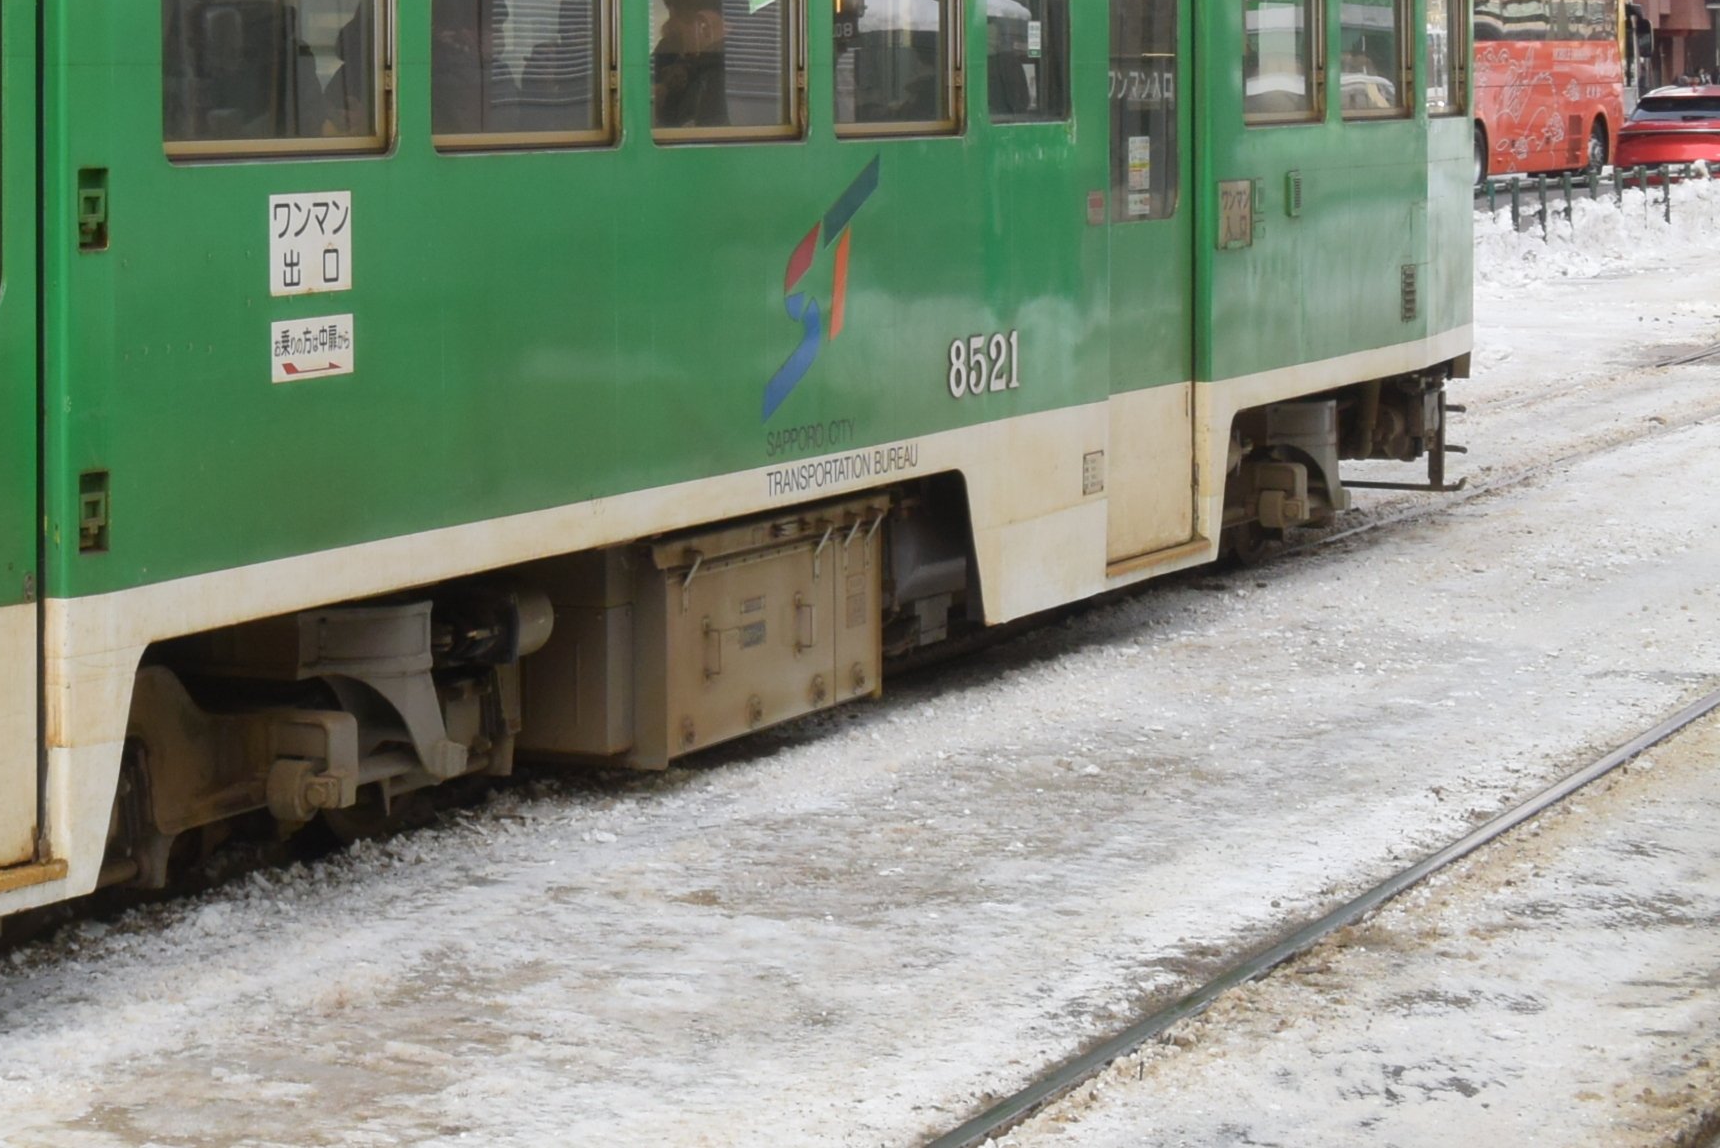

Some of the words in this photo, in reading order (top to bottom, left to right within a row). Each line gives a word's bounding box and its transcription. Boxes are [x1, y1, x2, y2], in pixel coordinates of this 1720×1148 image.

[273, 200, 349, 239] ワンマン
[283, 248, 340, 288] 出口
[274, 324, 351, 358] お乗りの方は中扉から
[947, 329, 1022, 400] 8521
[766, 423, 826, 458] SAPPORO
[828, 417, 857, 446] CITY
[766, 451, 872, 498] TRANSPORTATION
[873, 443, 919, 476] BUREAU
